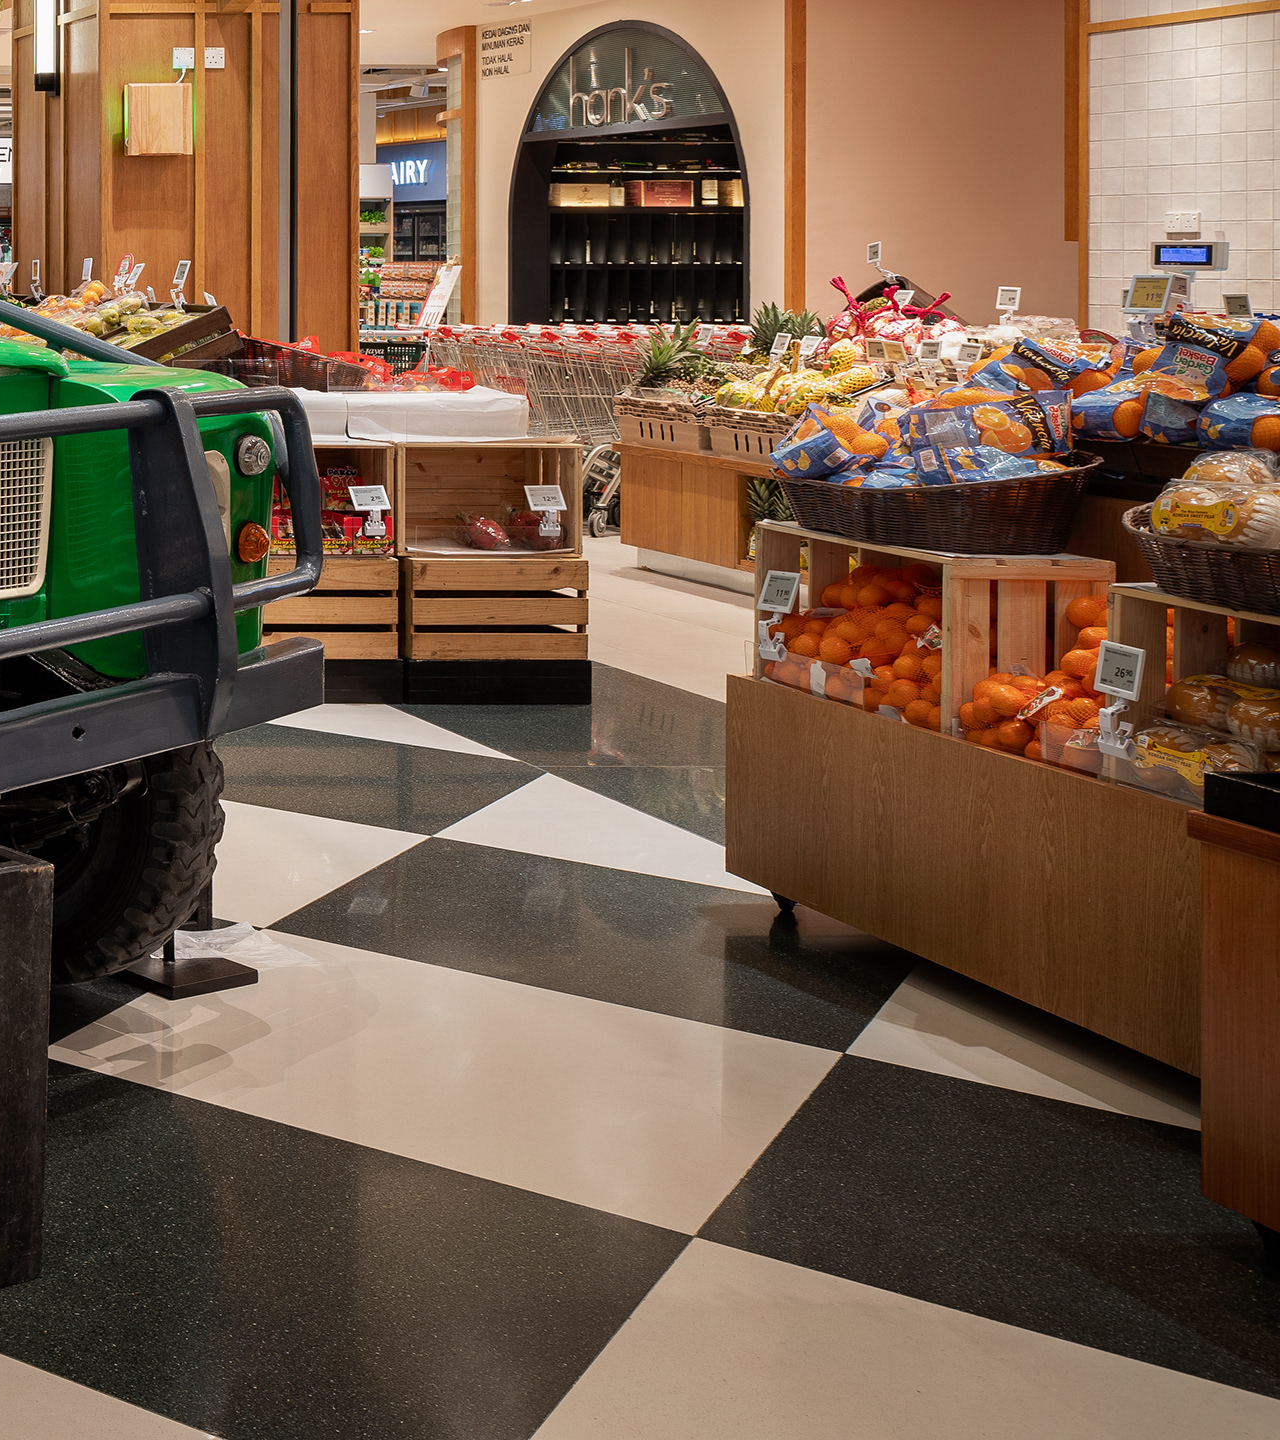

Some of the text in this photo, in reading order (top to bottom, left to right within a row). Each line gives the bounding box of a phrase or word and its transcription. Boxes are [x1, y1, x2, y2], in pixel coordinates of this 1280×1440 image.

[519, 23, 530, 33] DAN
[507, 36, 524, 47] KERAS
[482, 53, 513, 65] TIDAK HALAL
[482, 65, 509, 77] NON HALAL
[569, 47, 673, 127] hank's
[391, 159, 428, 185] AIRY
[1179, 347, 1218, 366] Basket
[1174, 356, 1214, 375] Garden
[1049, 406, 1062, 440] Basket
[331, 476, 357, 488] 916
